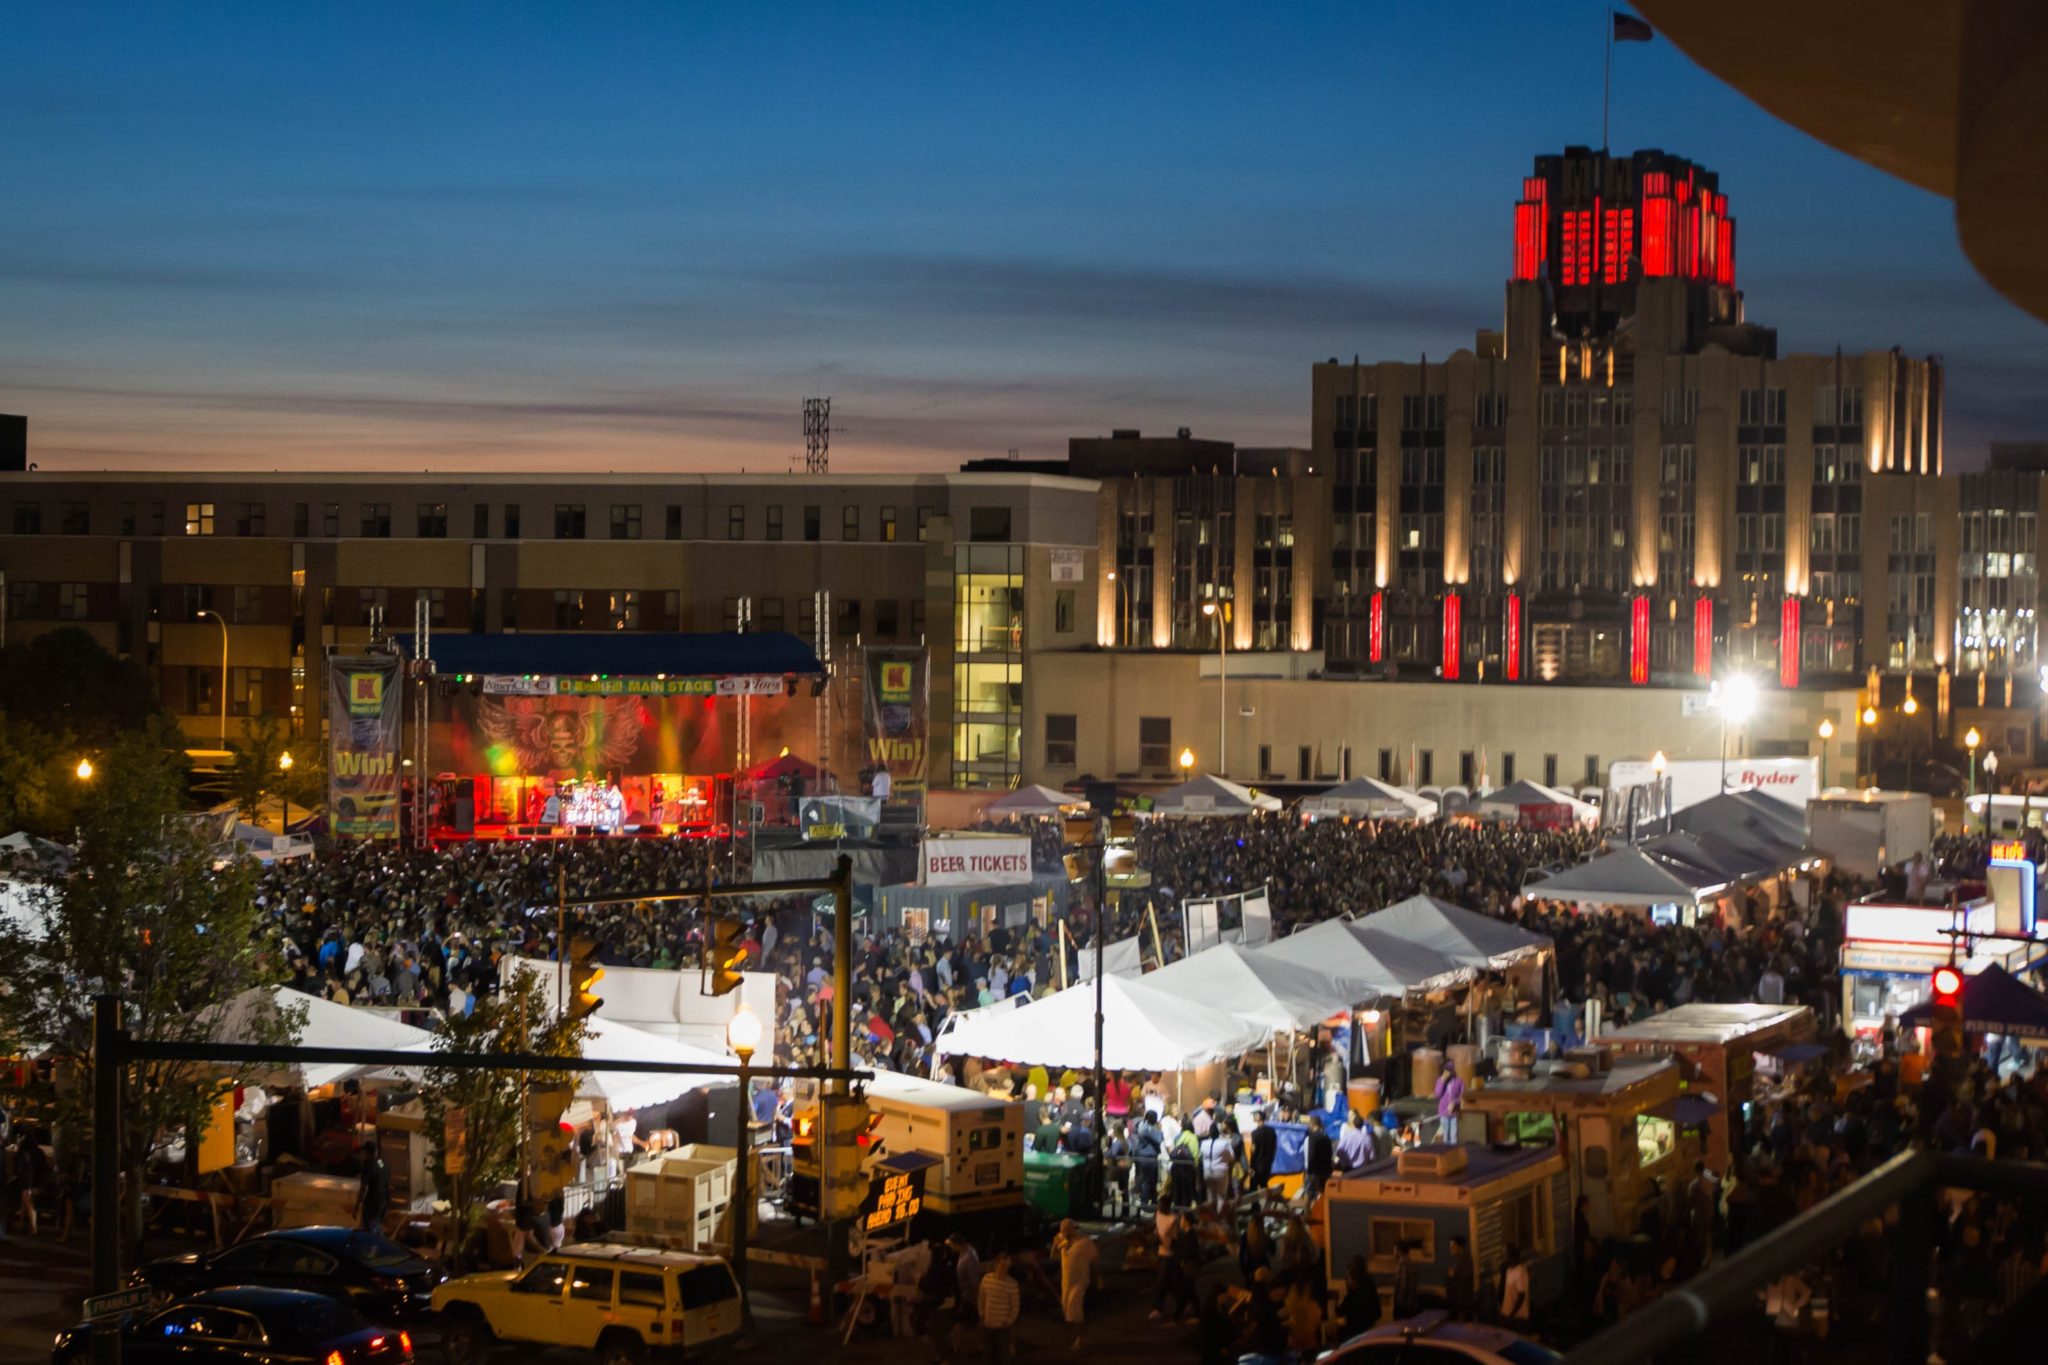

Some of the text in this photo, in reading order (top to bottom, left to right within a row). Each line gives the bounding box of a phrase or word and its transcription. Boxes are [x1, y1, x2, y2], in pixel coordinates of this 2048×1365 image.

[628, 680, 664, 692] MAIN
[668, 680, 713, 692] STAGE
[869, 738, 922, 762] Win!
[336, 752, 394, 777] Win!
[1741, 770, 1799, 787] Ryder
[930, 854, 1028, 873] BEER TICKETS
